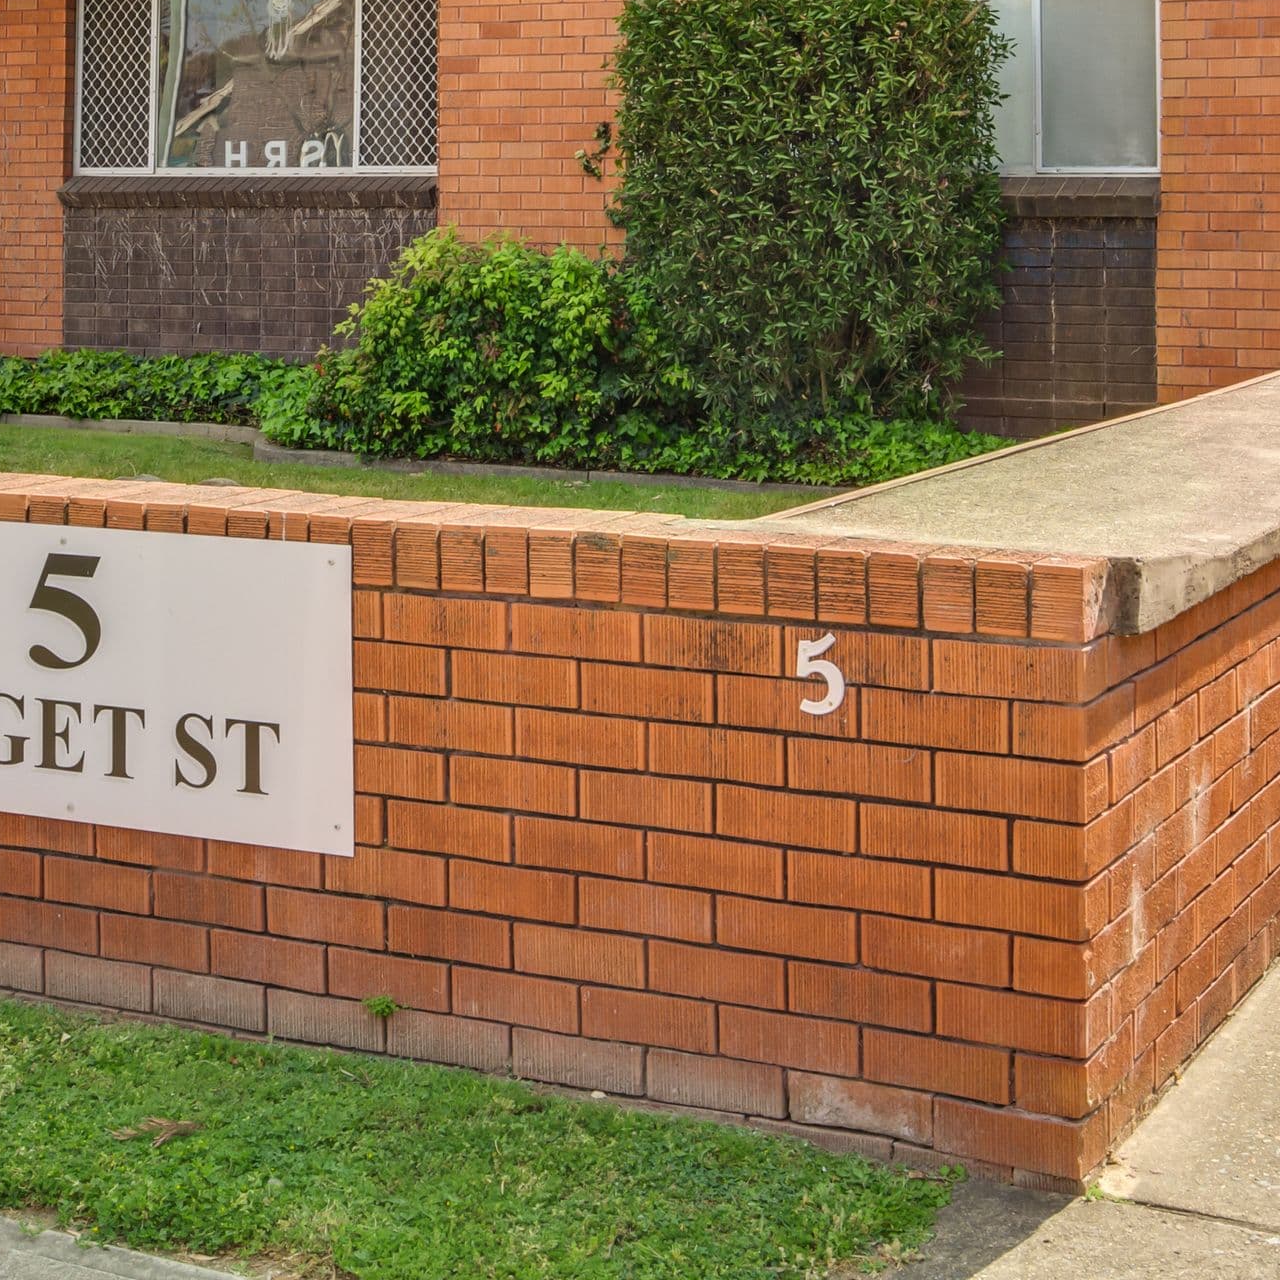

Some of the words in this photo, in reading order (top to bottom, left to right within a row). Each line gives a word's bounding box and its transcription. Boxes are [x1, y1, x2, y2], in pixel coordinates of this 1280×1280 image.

[28, 552, 102, 670] 5
[796, 632, 846, 716] 5
[174, 712, 281, 796] ST
